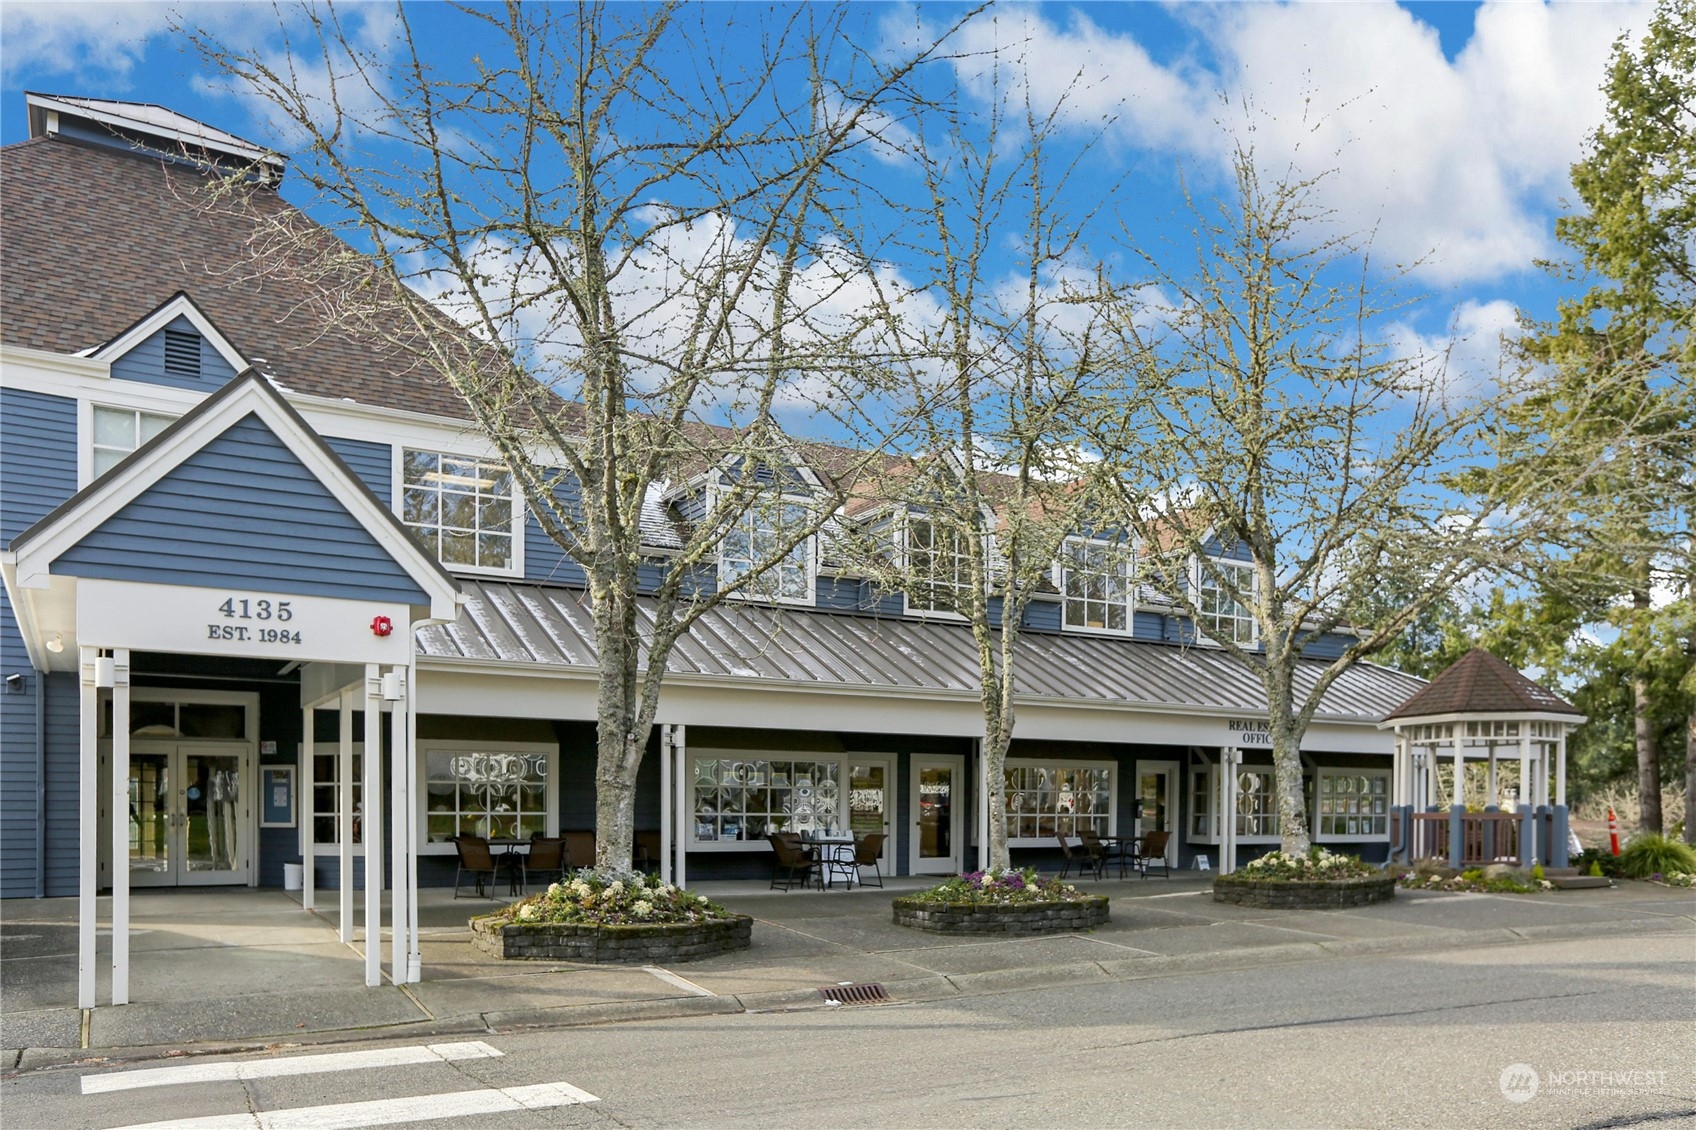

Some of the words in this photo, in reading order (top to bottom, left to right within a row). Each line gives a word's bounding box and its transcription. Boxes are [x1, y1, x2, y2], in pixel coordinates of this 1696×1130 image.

[218, 597, 292, 621] 4135
[207, 624, 251, 641] EST.
[258, 628, 302, 644] 1984
[1229, 720, 1255, 732] REAL
[1242, 732, 1272, 745] OFFIC
